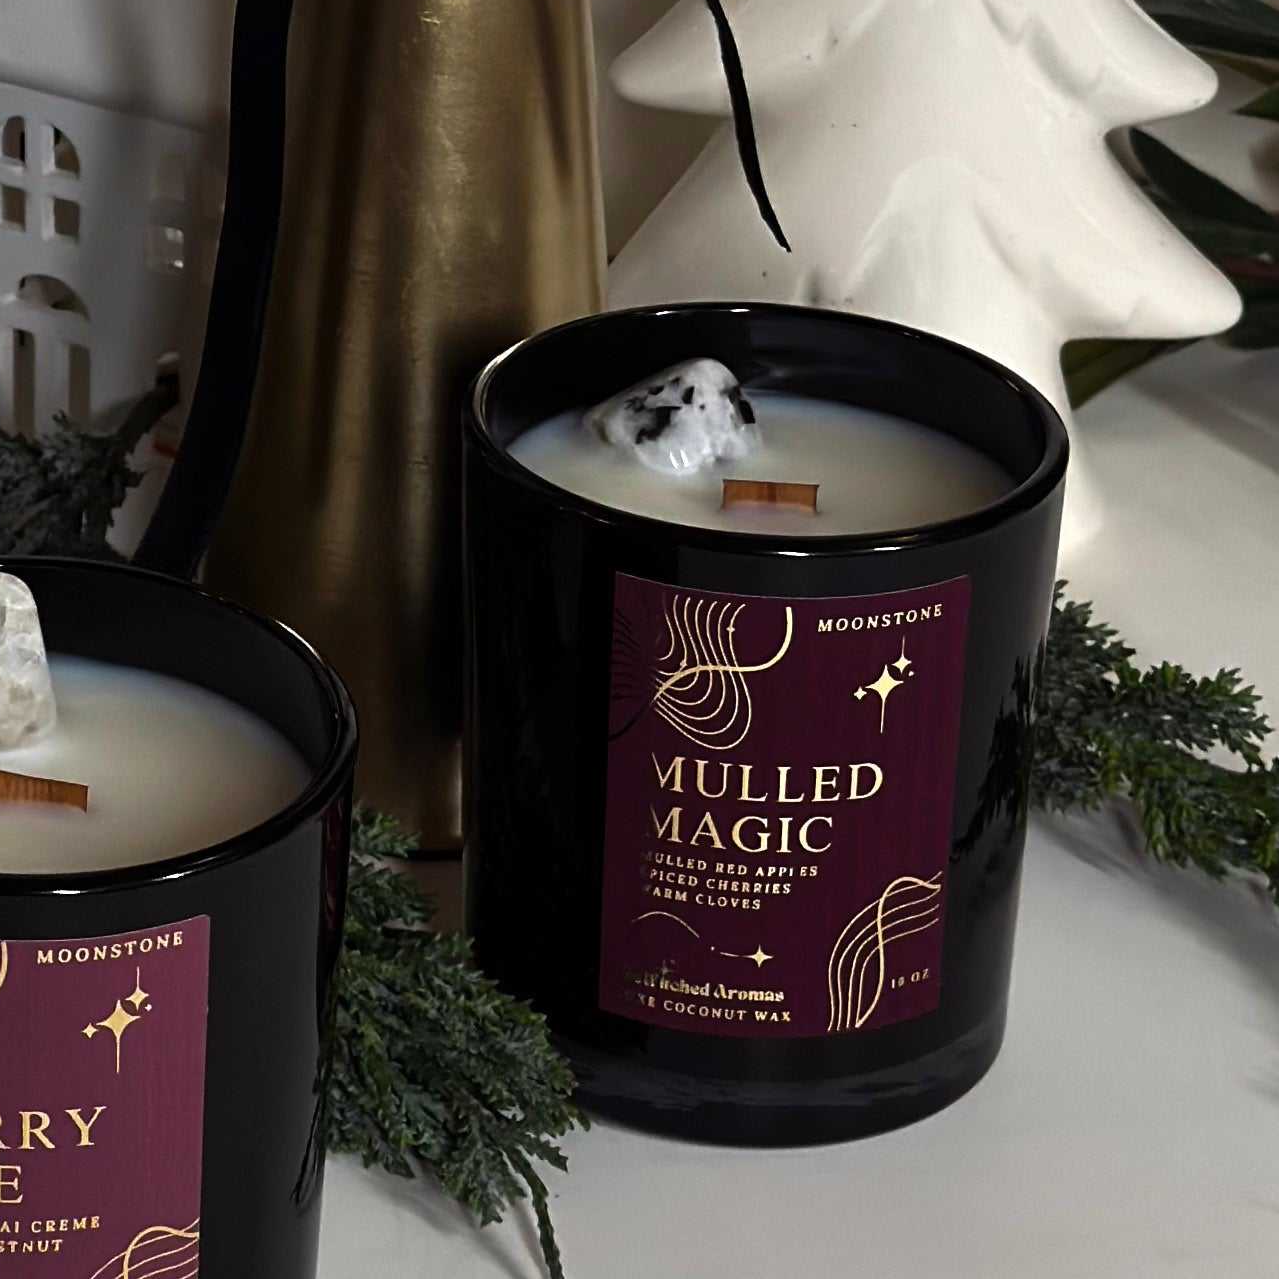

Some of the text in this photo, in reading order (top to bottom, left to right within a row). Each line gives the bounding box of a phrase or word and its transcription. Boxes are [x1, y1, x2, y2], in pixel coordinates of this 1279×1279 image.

[817, 603, 943, 633] MOONSTONE
[651, 751, 884, 803] MULLED
[648, 803, 834, 853] MAGIC
[642, 867, 792, 895] PICED CHERRIES
[714, 861, 748, 876] RED
[694, 892, 762, 911] CLOVES
[36, 931, 184, 964] MOONSTONE
[713, 982, 785, 1003] Aromas
[663, 999, 747, 1021] COCONUT
[754, 1009, 792, 1023] WAX
[31, 1215, 101, 1233] CREME
